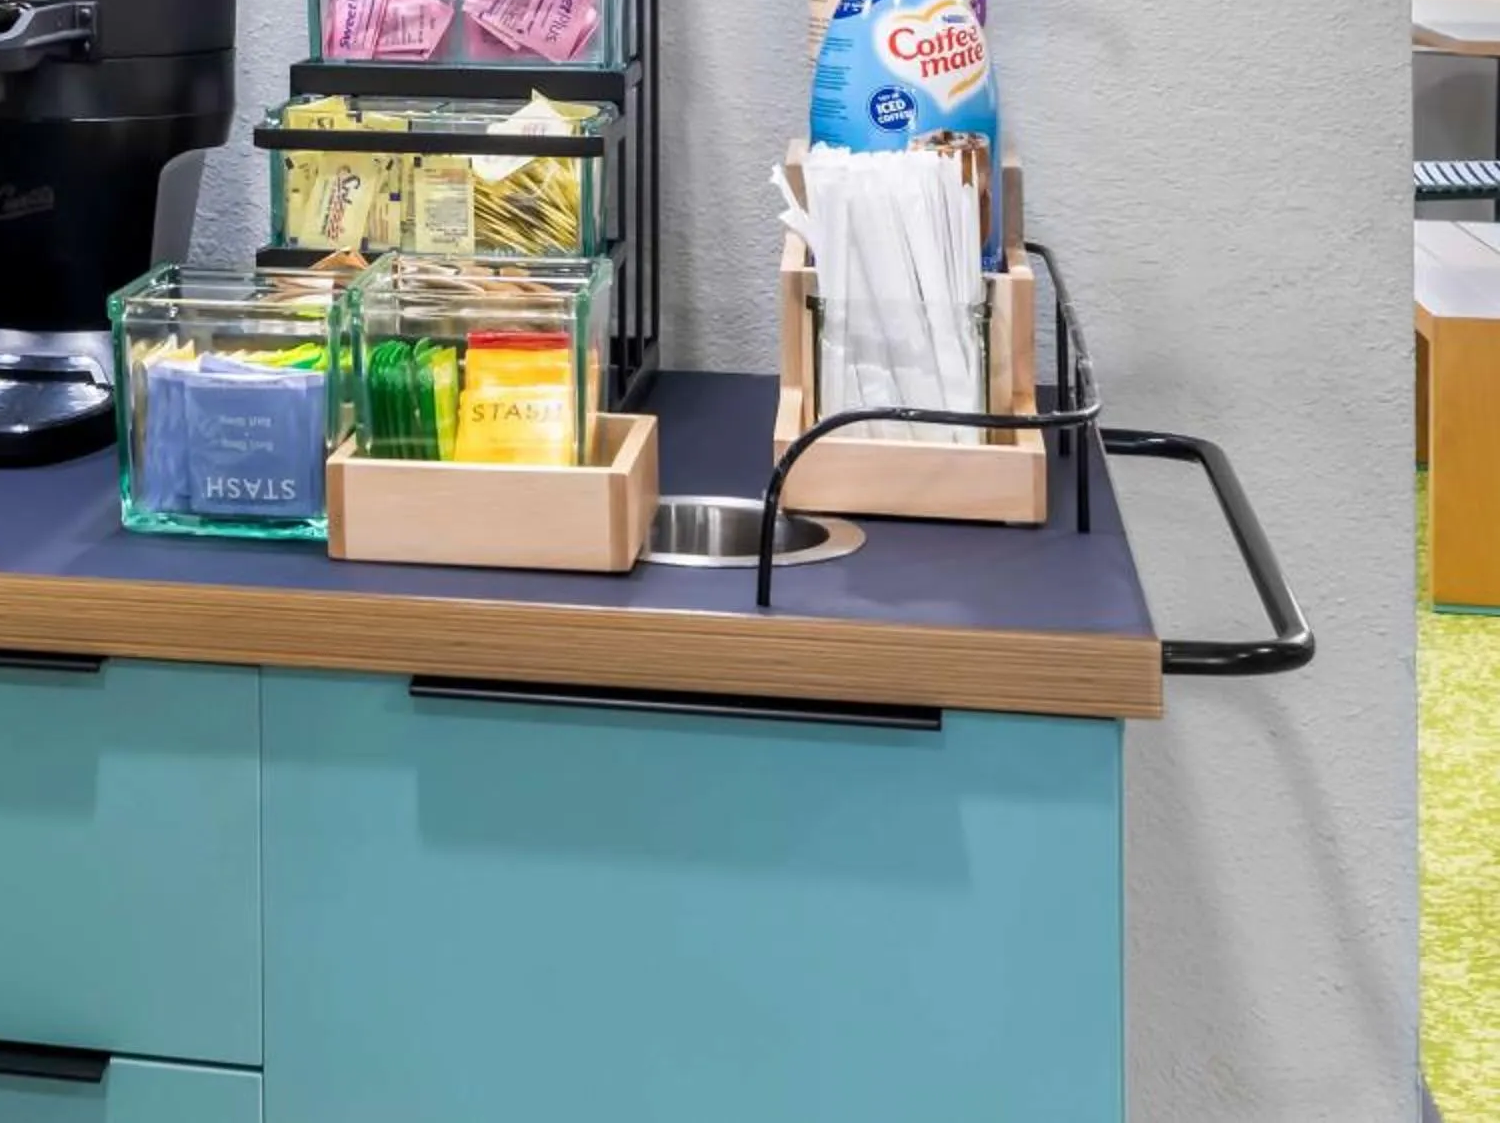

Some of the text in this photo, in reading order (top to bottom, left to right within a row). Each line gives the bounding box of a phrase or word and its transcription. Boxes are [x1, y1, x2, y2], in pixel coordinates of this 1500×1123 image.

[888, 25, 978, 60] Coffee
[920, 43, 984, 78] mate
[876, 98, 906, 115] ICED
[471, 403, 563, 423] STASH
[206, 477, 296, 500] STASH
